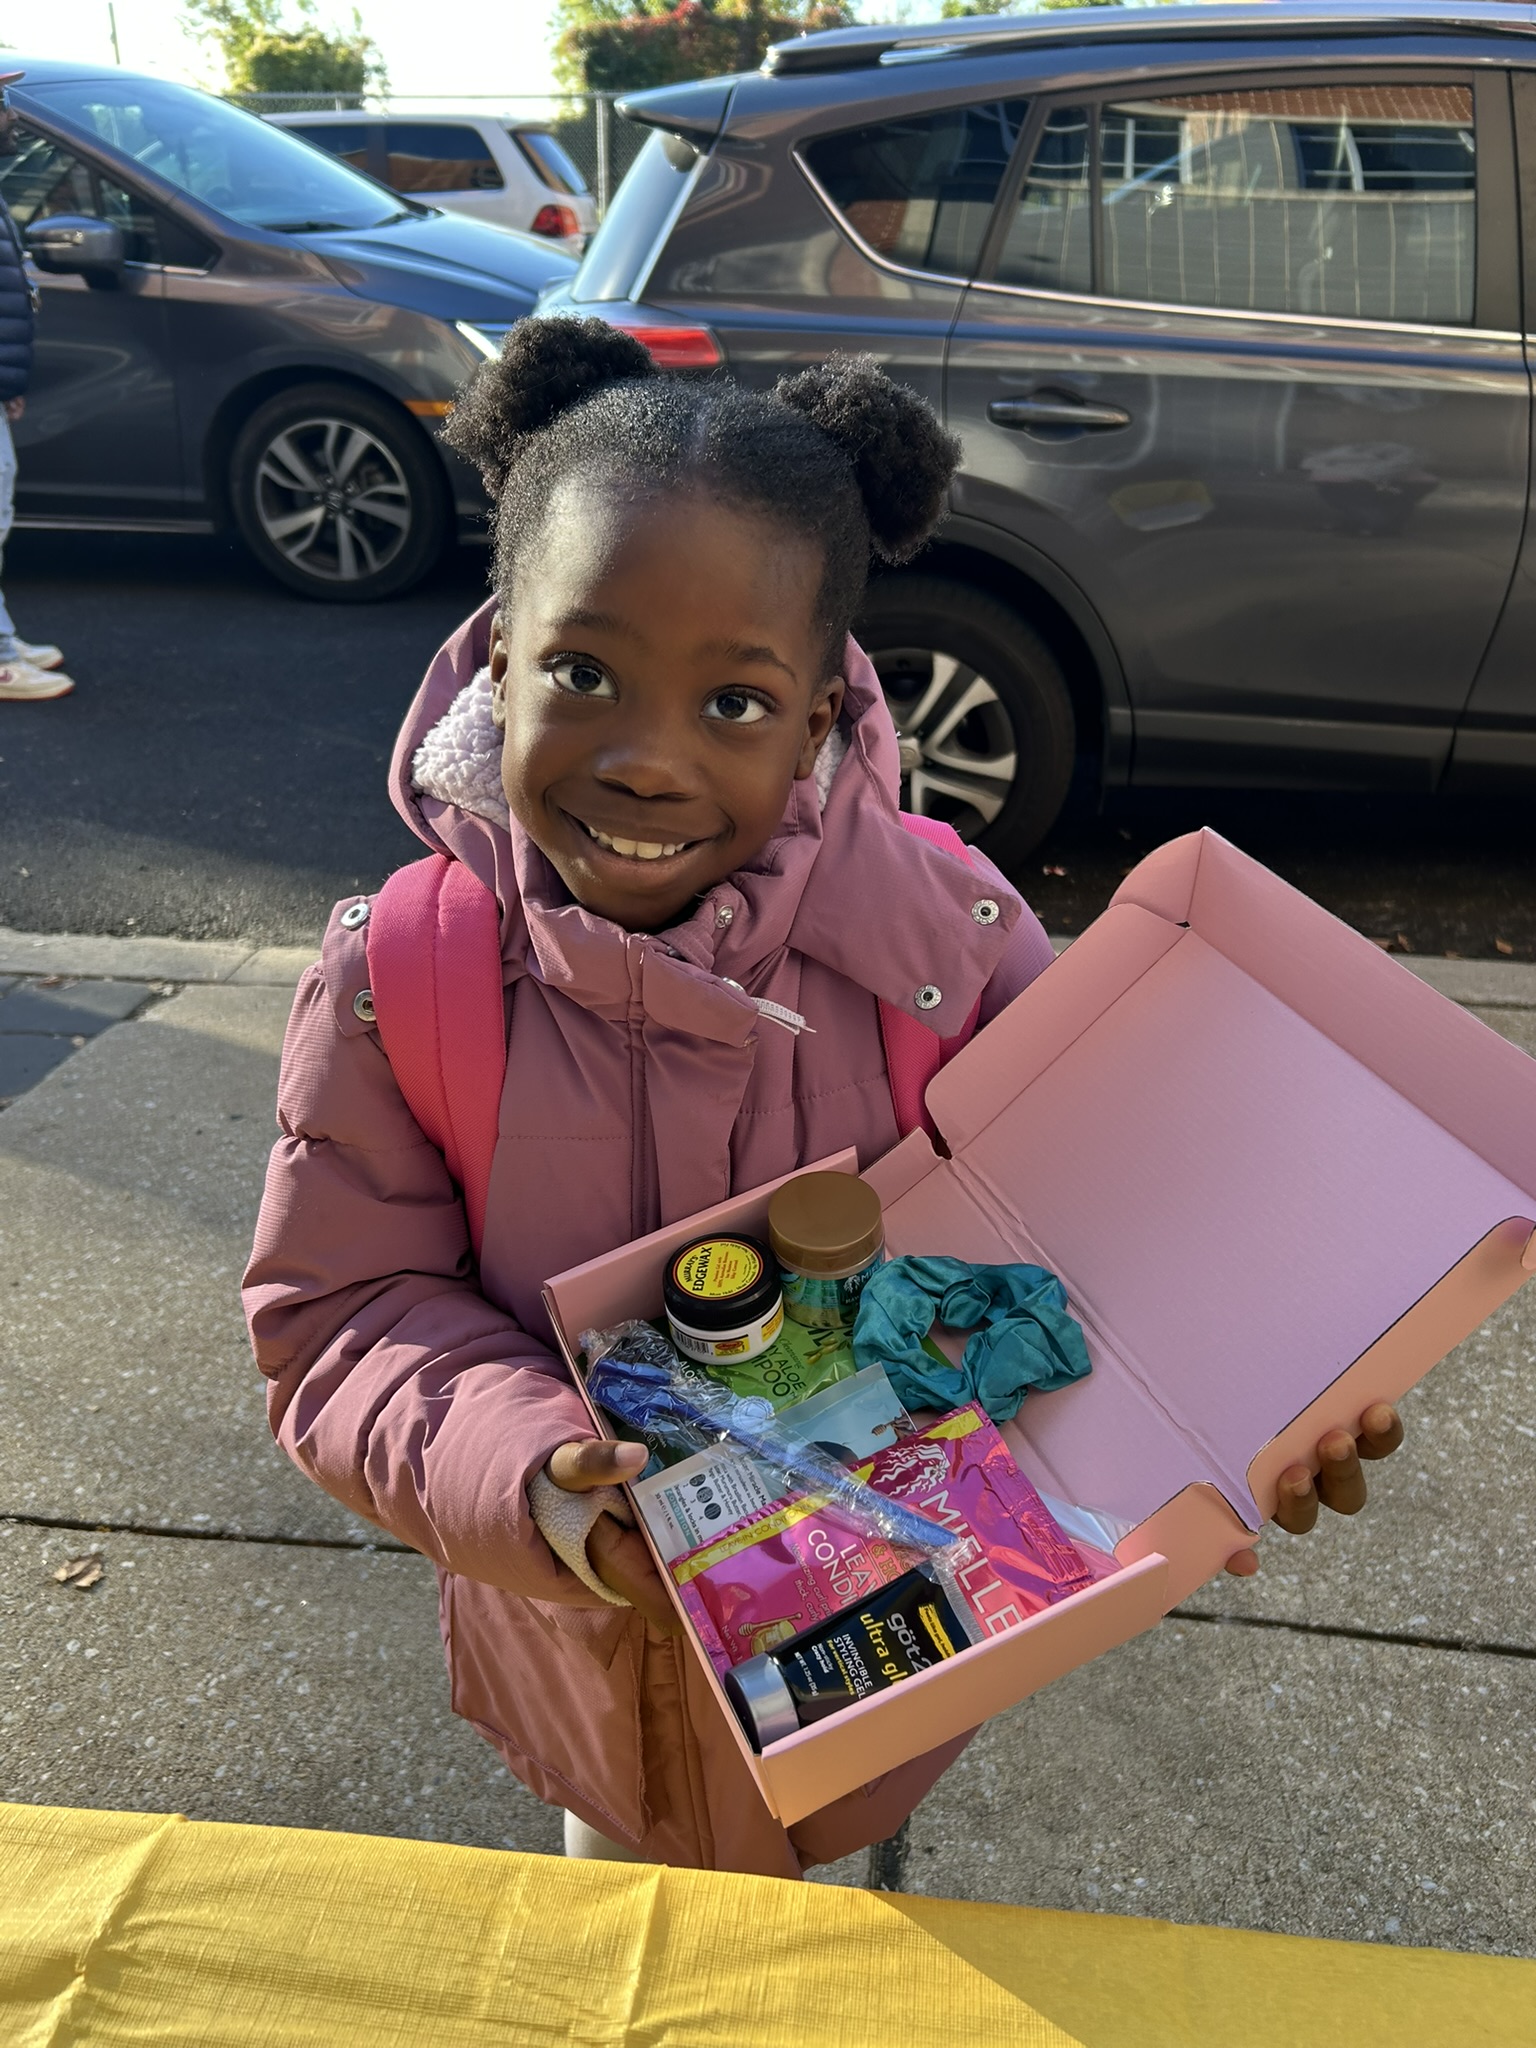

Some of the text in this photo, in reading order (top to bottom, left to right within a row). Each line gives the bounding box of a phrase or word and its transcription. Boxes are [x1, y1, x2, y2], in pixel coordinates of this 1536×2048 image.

[691, 1246, 712, 1291] EDGEWAX
[773, 1354, 807, 1391] ALOE
[745, 1471, 763, 1495] Miracle
[663, 1489, 693, 1537] CONDITION
[720, 1497, 735, 1516] Honey
[685, 1512, 699, 1529] locks
[692, 1526, 701, 1535] in
[871, 1542, 888, 1559] &
[812, 1583, 828, 1602] curl
[720, 1624, 732, 1639] Net
[859, 1611, 894, 1658] ultra
[928, 1621, 939, 1633] like
[810, 1644, 829, 1674] Crazy hold
[817, 1642, 834, 1671] Non-sticky
[825, 1638, 857, 1696] For vertical styles
[832, 1634, 867, 1699] STYLING GEL
[841, 1632, 873, 1689] INVINCIBLE
